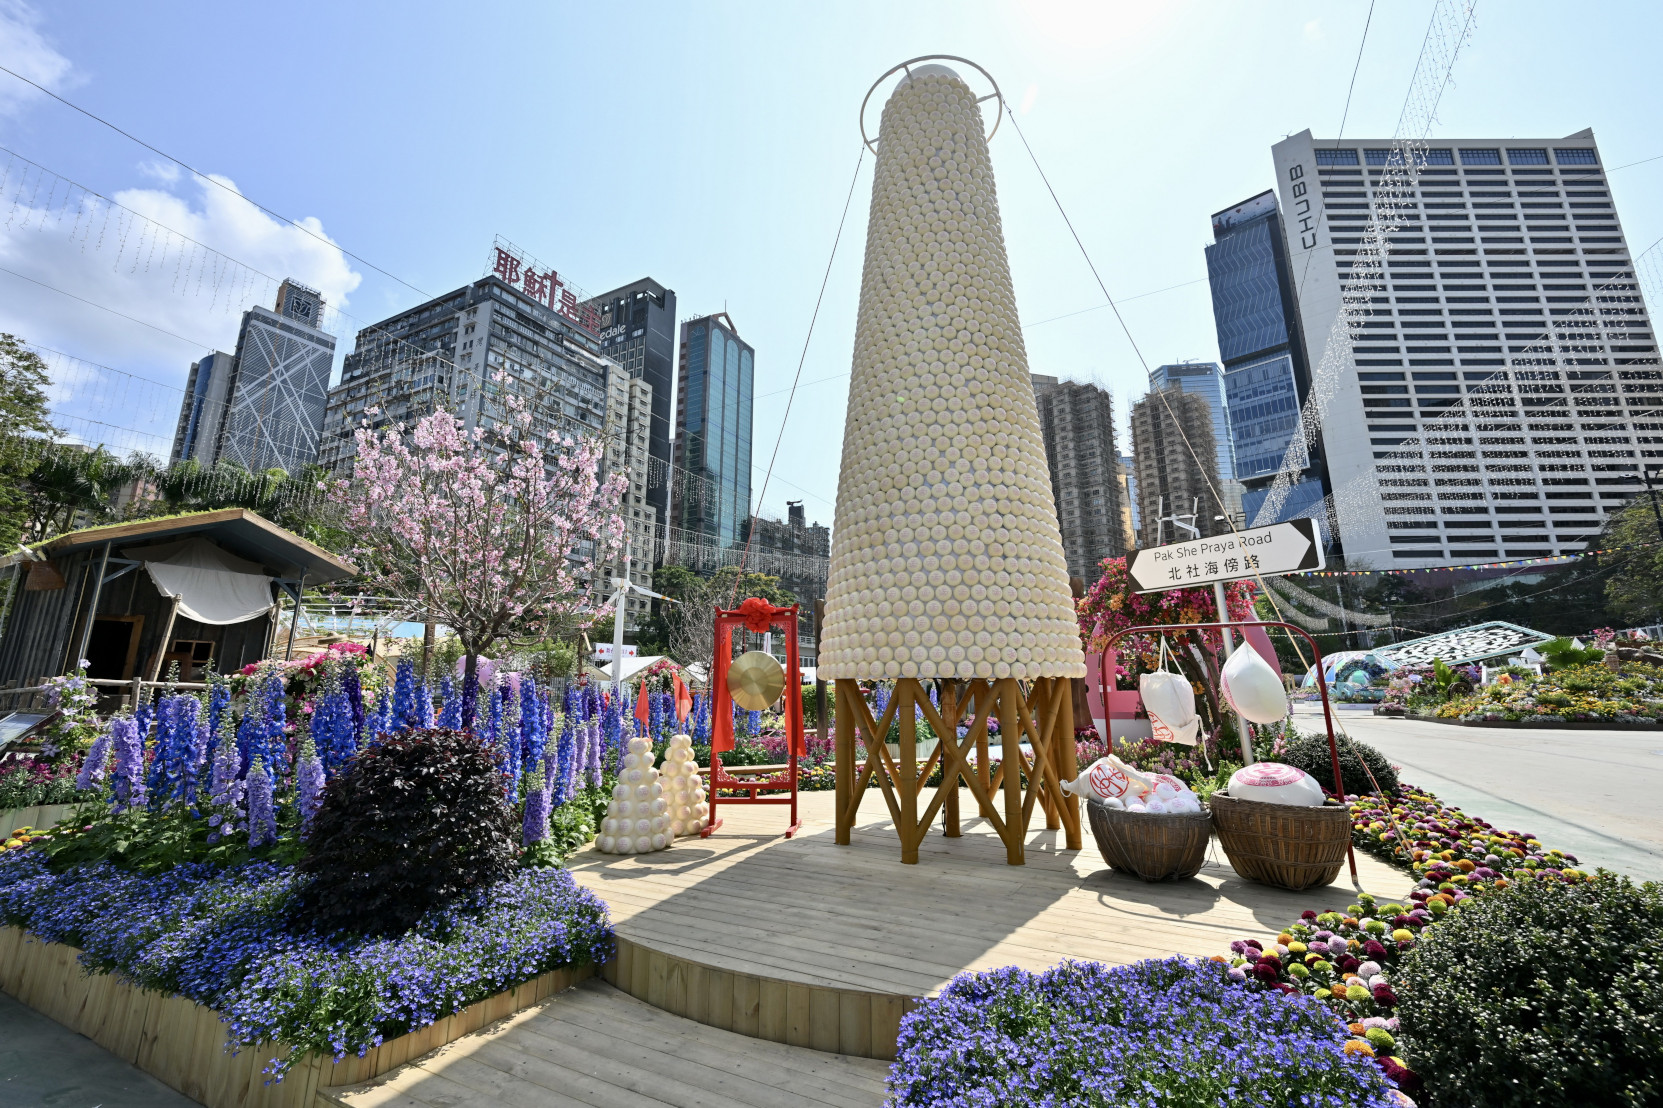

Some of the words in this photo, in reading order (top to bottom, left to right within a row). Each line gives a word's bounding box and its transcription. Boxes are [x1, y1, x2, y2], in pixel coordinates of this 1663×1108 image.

[1289, 164, 1317, 250] CHUBB
[1154, 550, 1174, 562] Pak
[1176, 547, 1198, 559] She
[1201, 539, 1235, 555] Praya
[1239, 531, 1273, 548] Road
[1168, 554, 1260, 581] 北社海傍路
